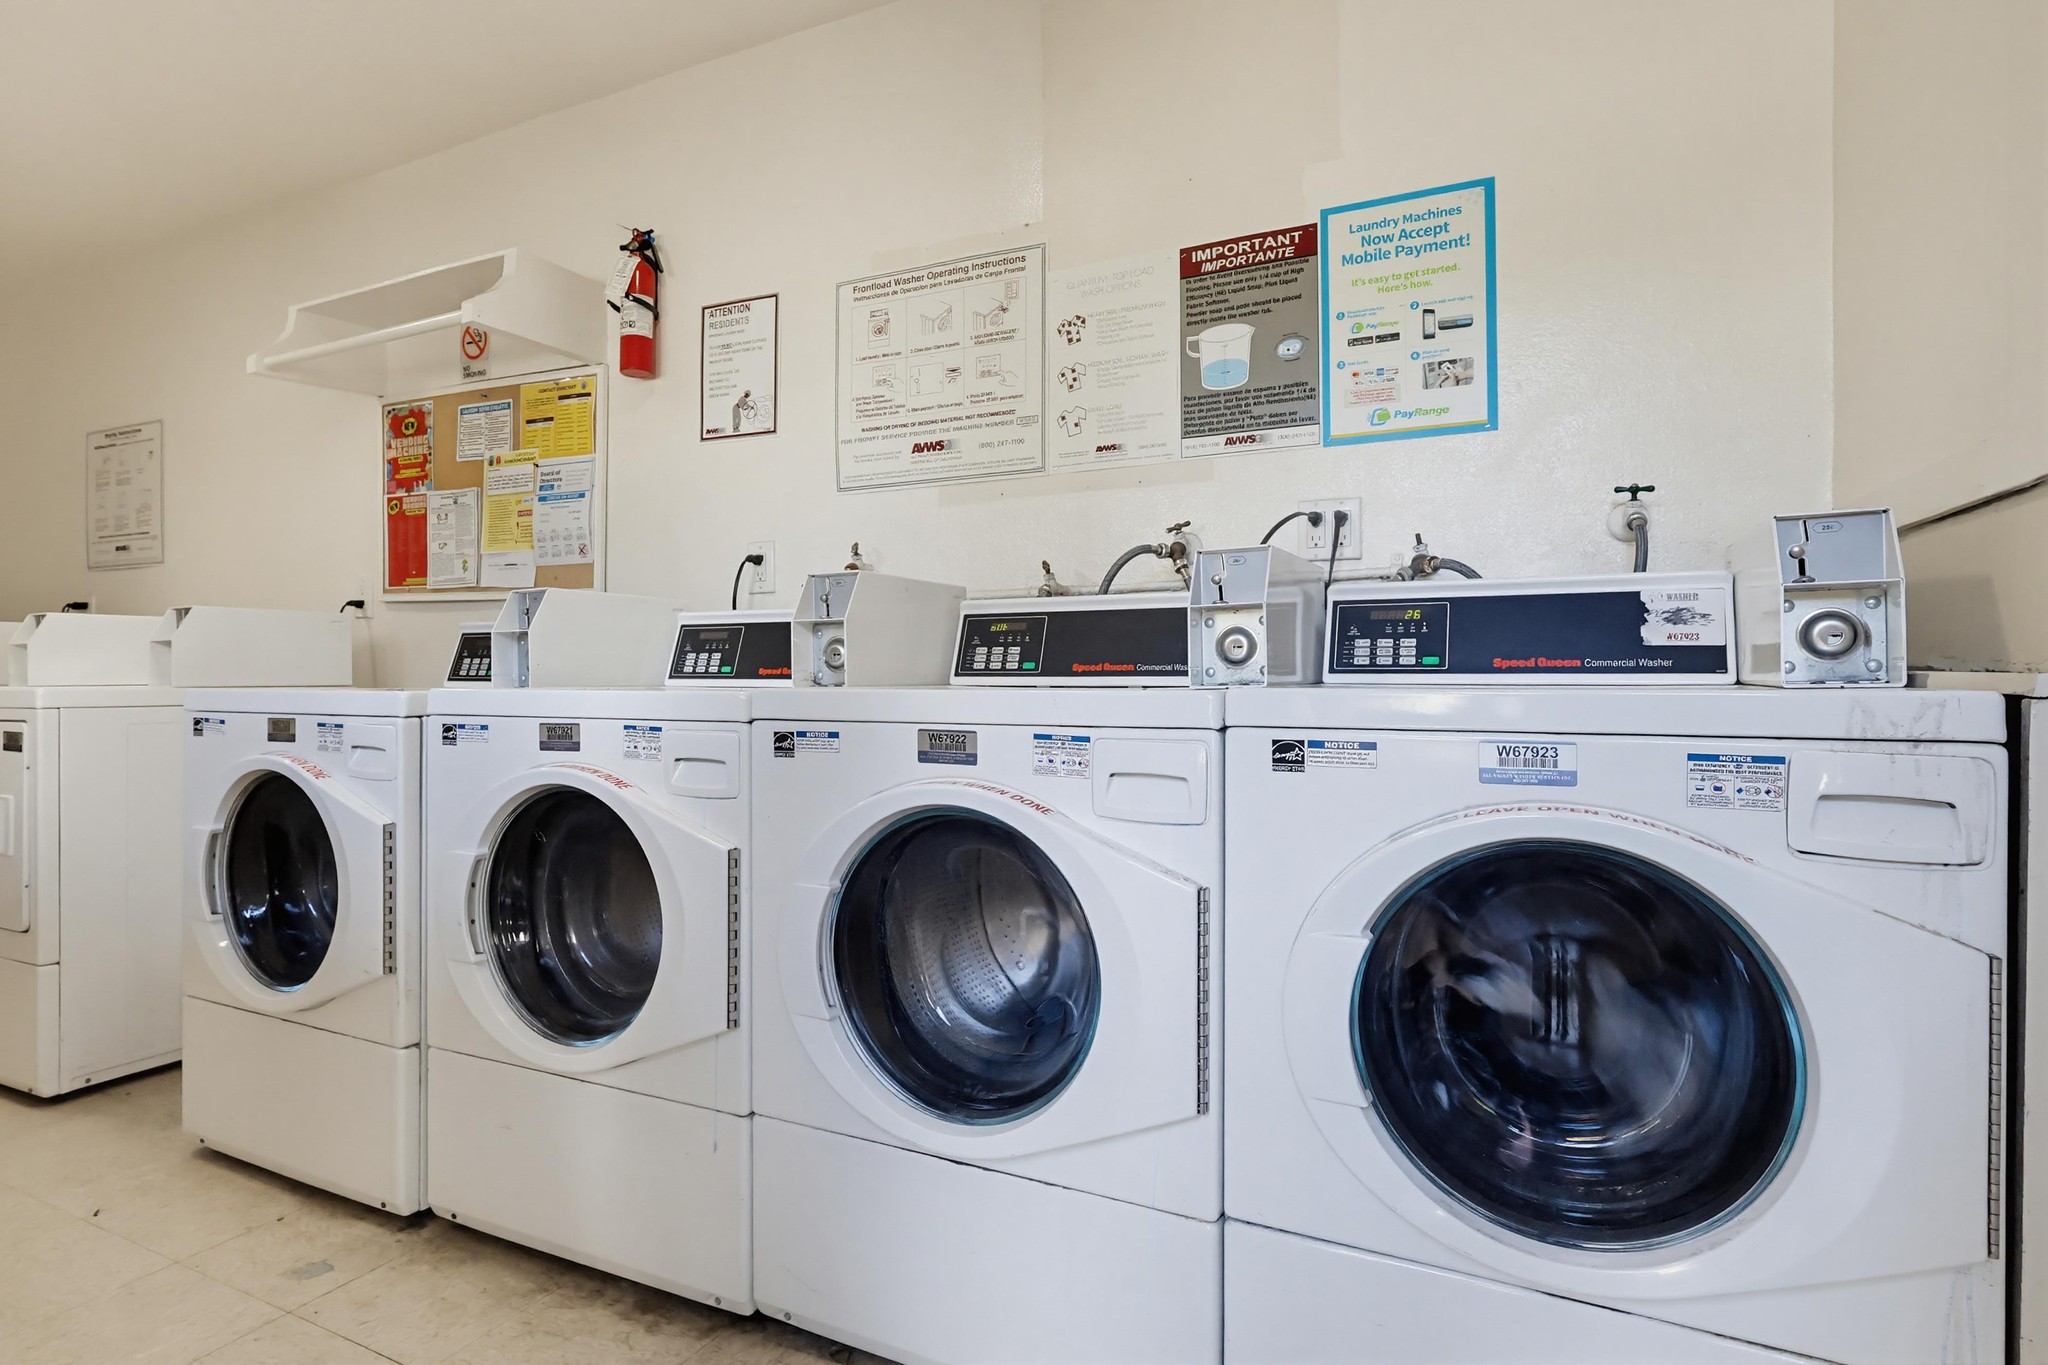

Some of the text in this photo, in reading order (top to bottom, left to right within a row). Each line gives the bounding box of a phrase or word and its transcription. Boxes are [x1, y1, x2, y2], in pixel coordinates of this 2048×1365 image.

[1349, 206, 1462, 234] Laundry Machines
[1360, 221, 1450, 248] Now Accept
[1191, 230, 1303, 263] IMPORTANT
[1341, 233, 1471, 267] Mobile Payment!
[1200, 245, 1296, 273] IMPORTANTE
[853, 254, 1027, 294] Frontload Washer Operating Instructions
[891, 289, 899, 297] de
[984, 269, 1003, 279] Carga
[1003, 265, 1027, 276] Frontal
[1351, 262, 1460, 287] It's easy to get started.
[1377, 278, 1433, 294] Here's how.
[709, 303, 751, 319] ATTENTION
[709, 316, 750, 330] RESIDENTS
[463, 369, 487, 379] SMOKING
[1393, 405, 1450, 419] PayRange
[938, 427, 951, 435] THE
[1404, 609, 1421, 620] 26
[1071, 662, 1173, 673] Speed Queen Commercial
[1493, 657, 1673, 669] Speed Queen Commercial Washer
[546, 726, 573, 735] W67921
[928, 732, 967, 744] W67922
[1324, 741, 1360, 750] NOTICE
[1496, 745, 1559, 759] W67923
[1719, 755, 1753, 763] NOTICE
[1010, 794, 1055, 816] DONE
[1463, 805, 1530, 819] LEAVE
[1537, 805, 1600, 816] OPEN
